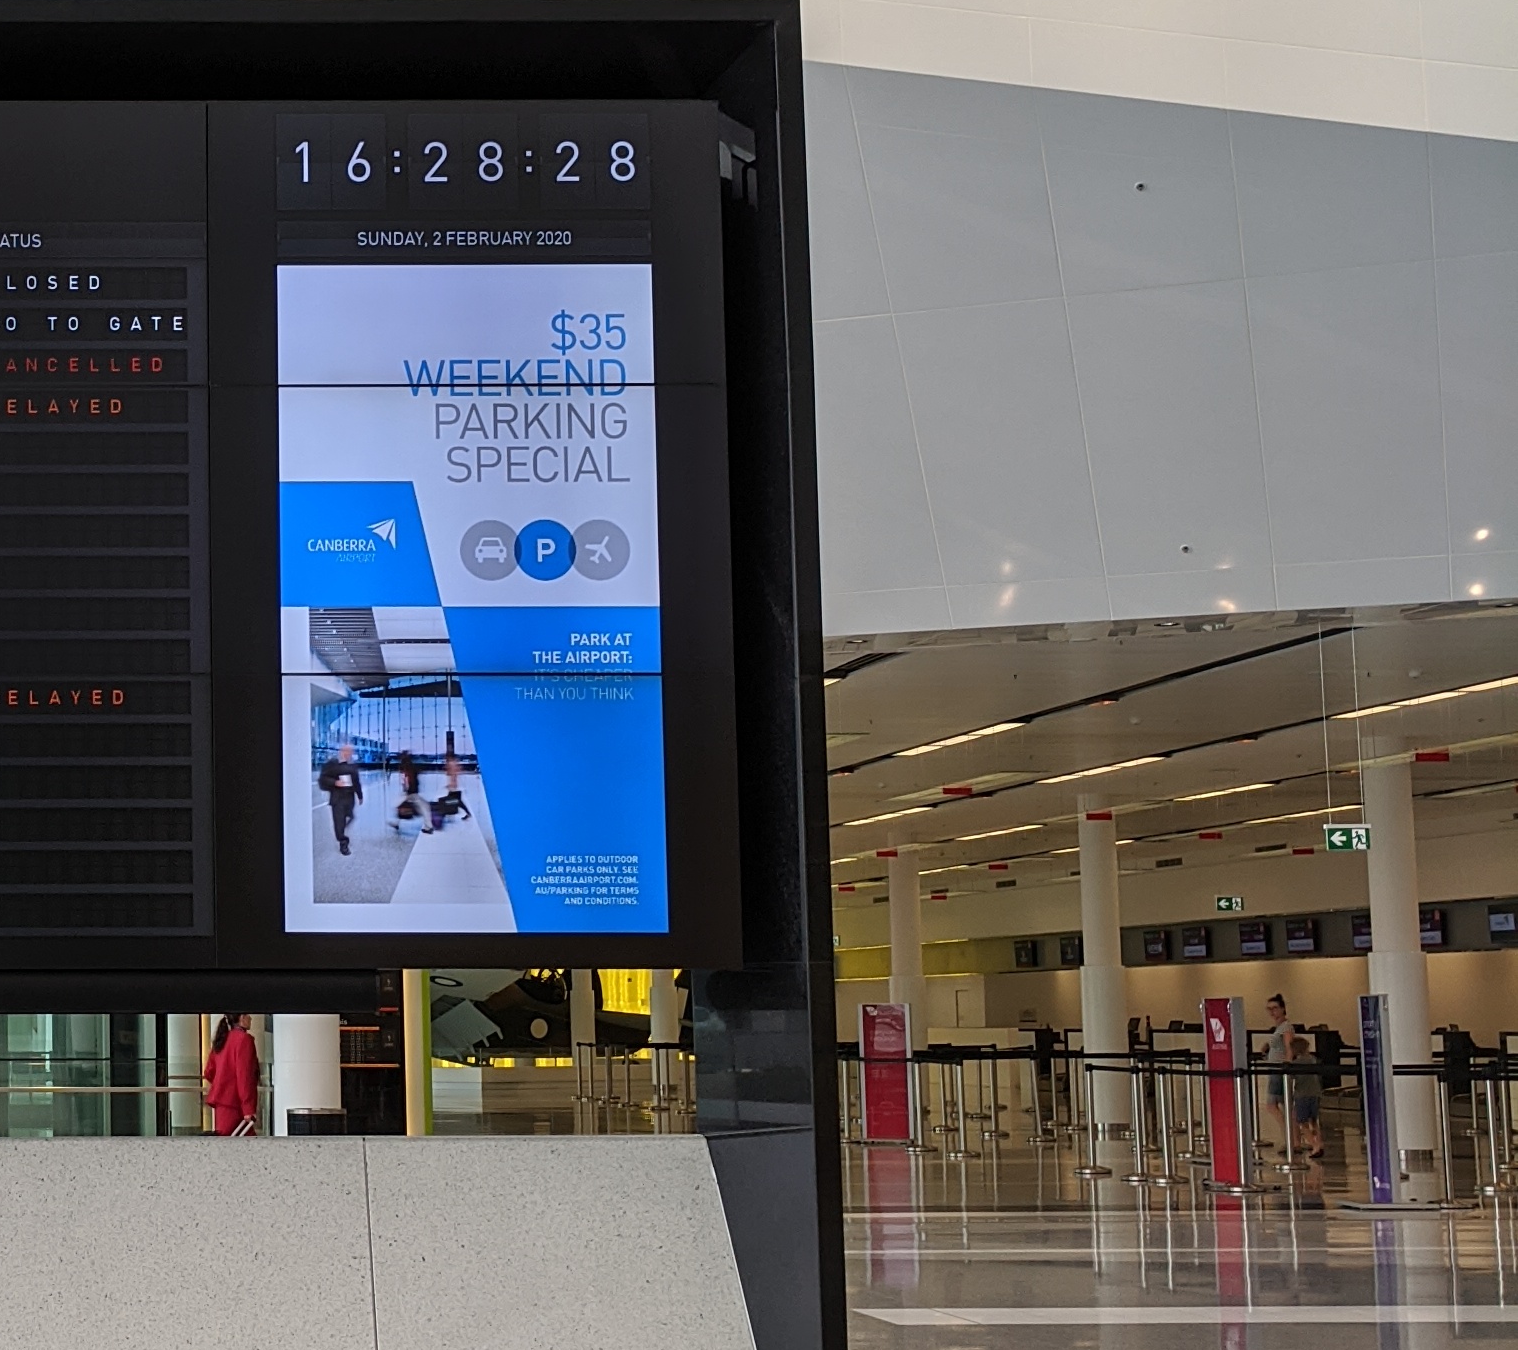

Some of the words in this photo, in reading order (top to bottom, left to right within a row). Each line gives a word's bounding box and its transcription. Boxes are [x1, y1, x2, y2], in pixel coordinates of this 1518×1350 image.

[295, 140, 636, 183] 16:28:28
[357, 231, 428, 247] SUNDAY,
[432, 231, 442, 246] 2
[446, 231, 533, 246] FEBRUARY
[536, 231, 572, 245] 2020
[47, 316, 79, 331] TO
[109, 316, 183, 331] GATE
[550, 309, 627, 355] $35
[403, 359, 627, 397] WEEKEND
[435, 403, 627, 440] PARKING
[446, 446, 630, 483] SPECIAL
[307, 539, 376, 551] CANBERRA
[570, 633, 610, 646] PARK
[614, 633, 632, 646] AT
[533, 651, 562, 663] THE
[565, 651, 632, 663] AIRPORT:
[515, 688, 554, 700] THAN
[559, 688, 586, 700] YOU
[592, 688, 633, 700] THINK
[565, 897, 582, 905] AND
